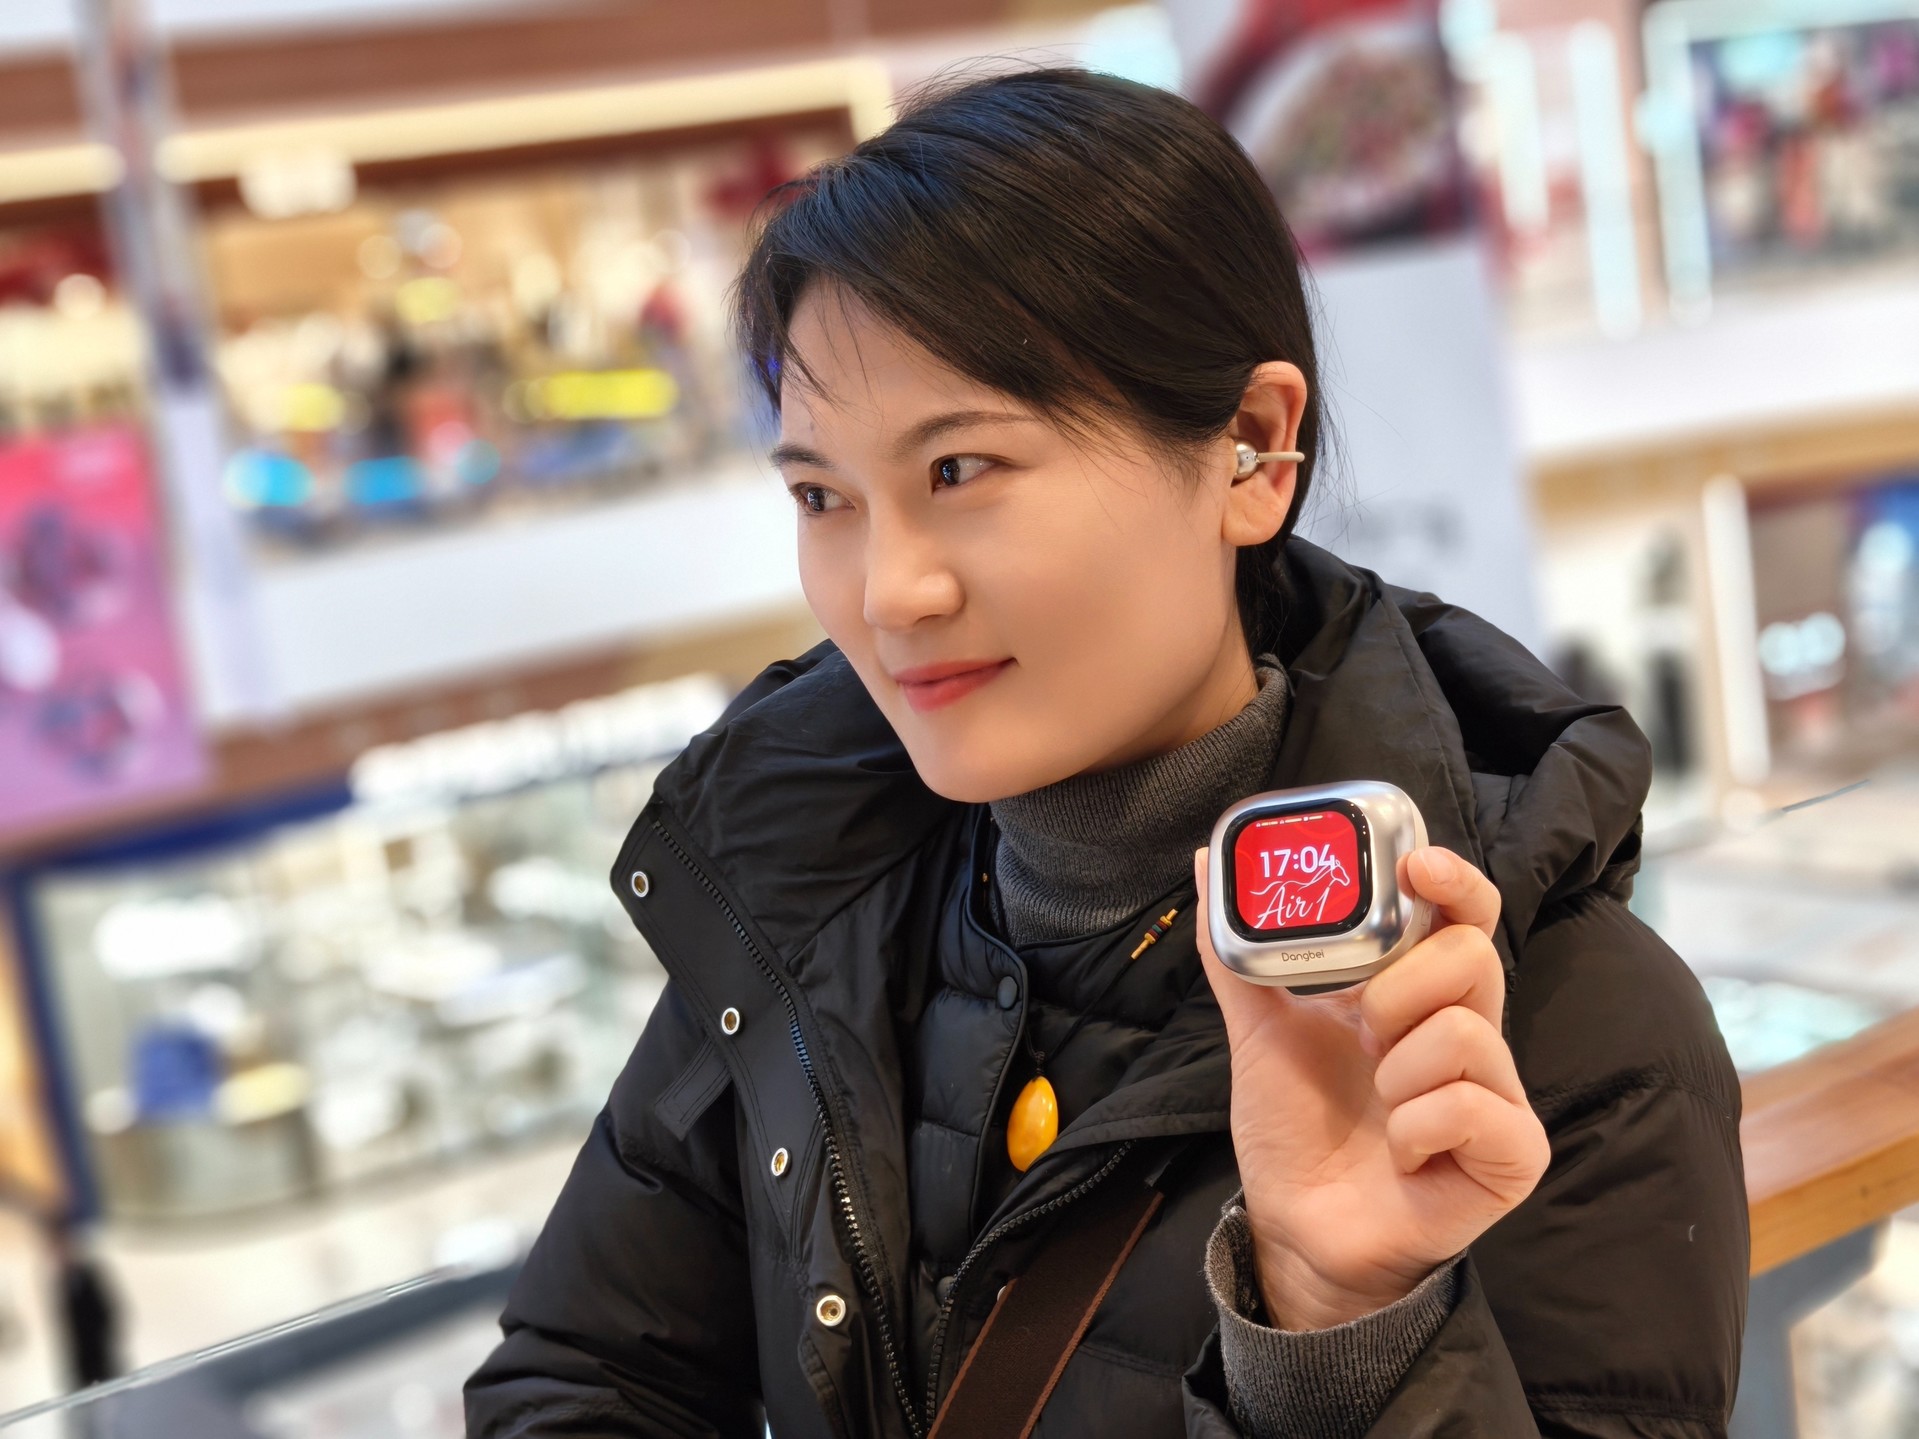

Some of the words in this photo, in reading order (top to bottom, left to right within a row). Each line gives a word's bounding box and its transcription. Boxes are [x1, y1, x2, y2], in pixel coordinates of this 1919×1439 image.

[1260, 844, 1336, 878] 17:04
[1254, 885, 1313, 929] Air
[1316, 886, 1331, 922] 1
[1281, 949, 1325, 962] Dangbei
